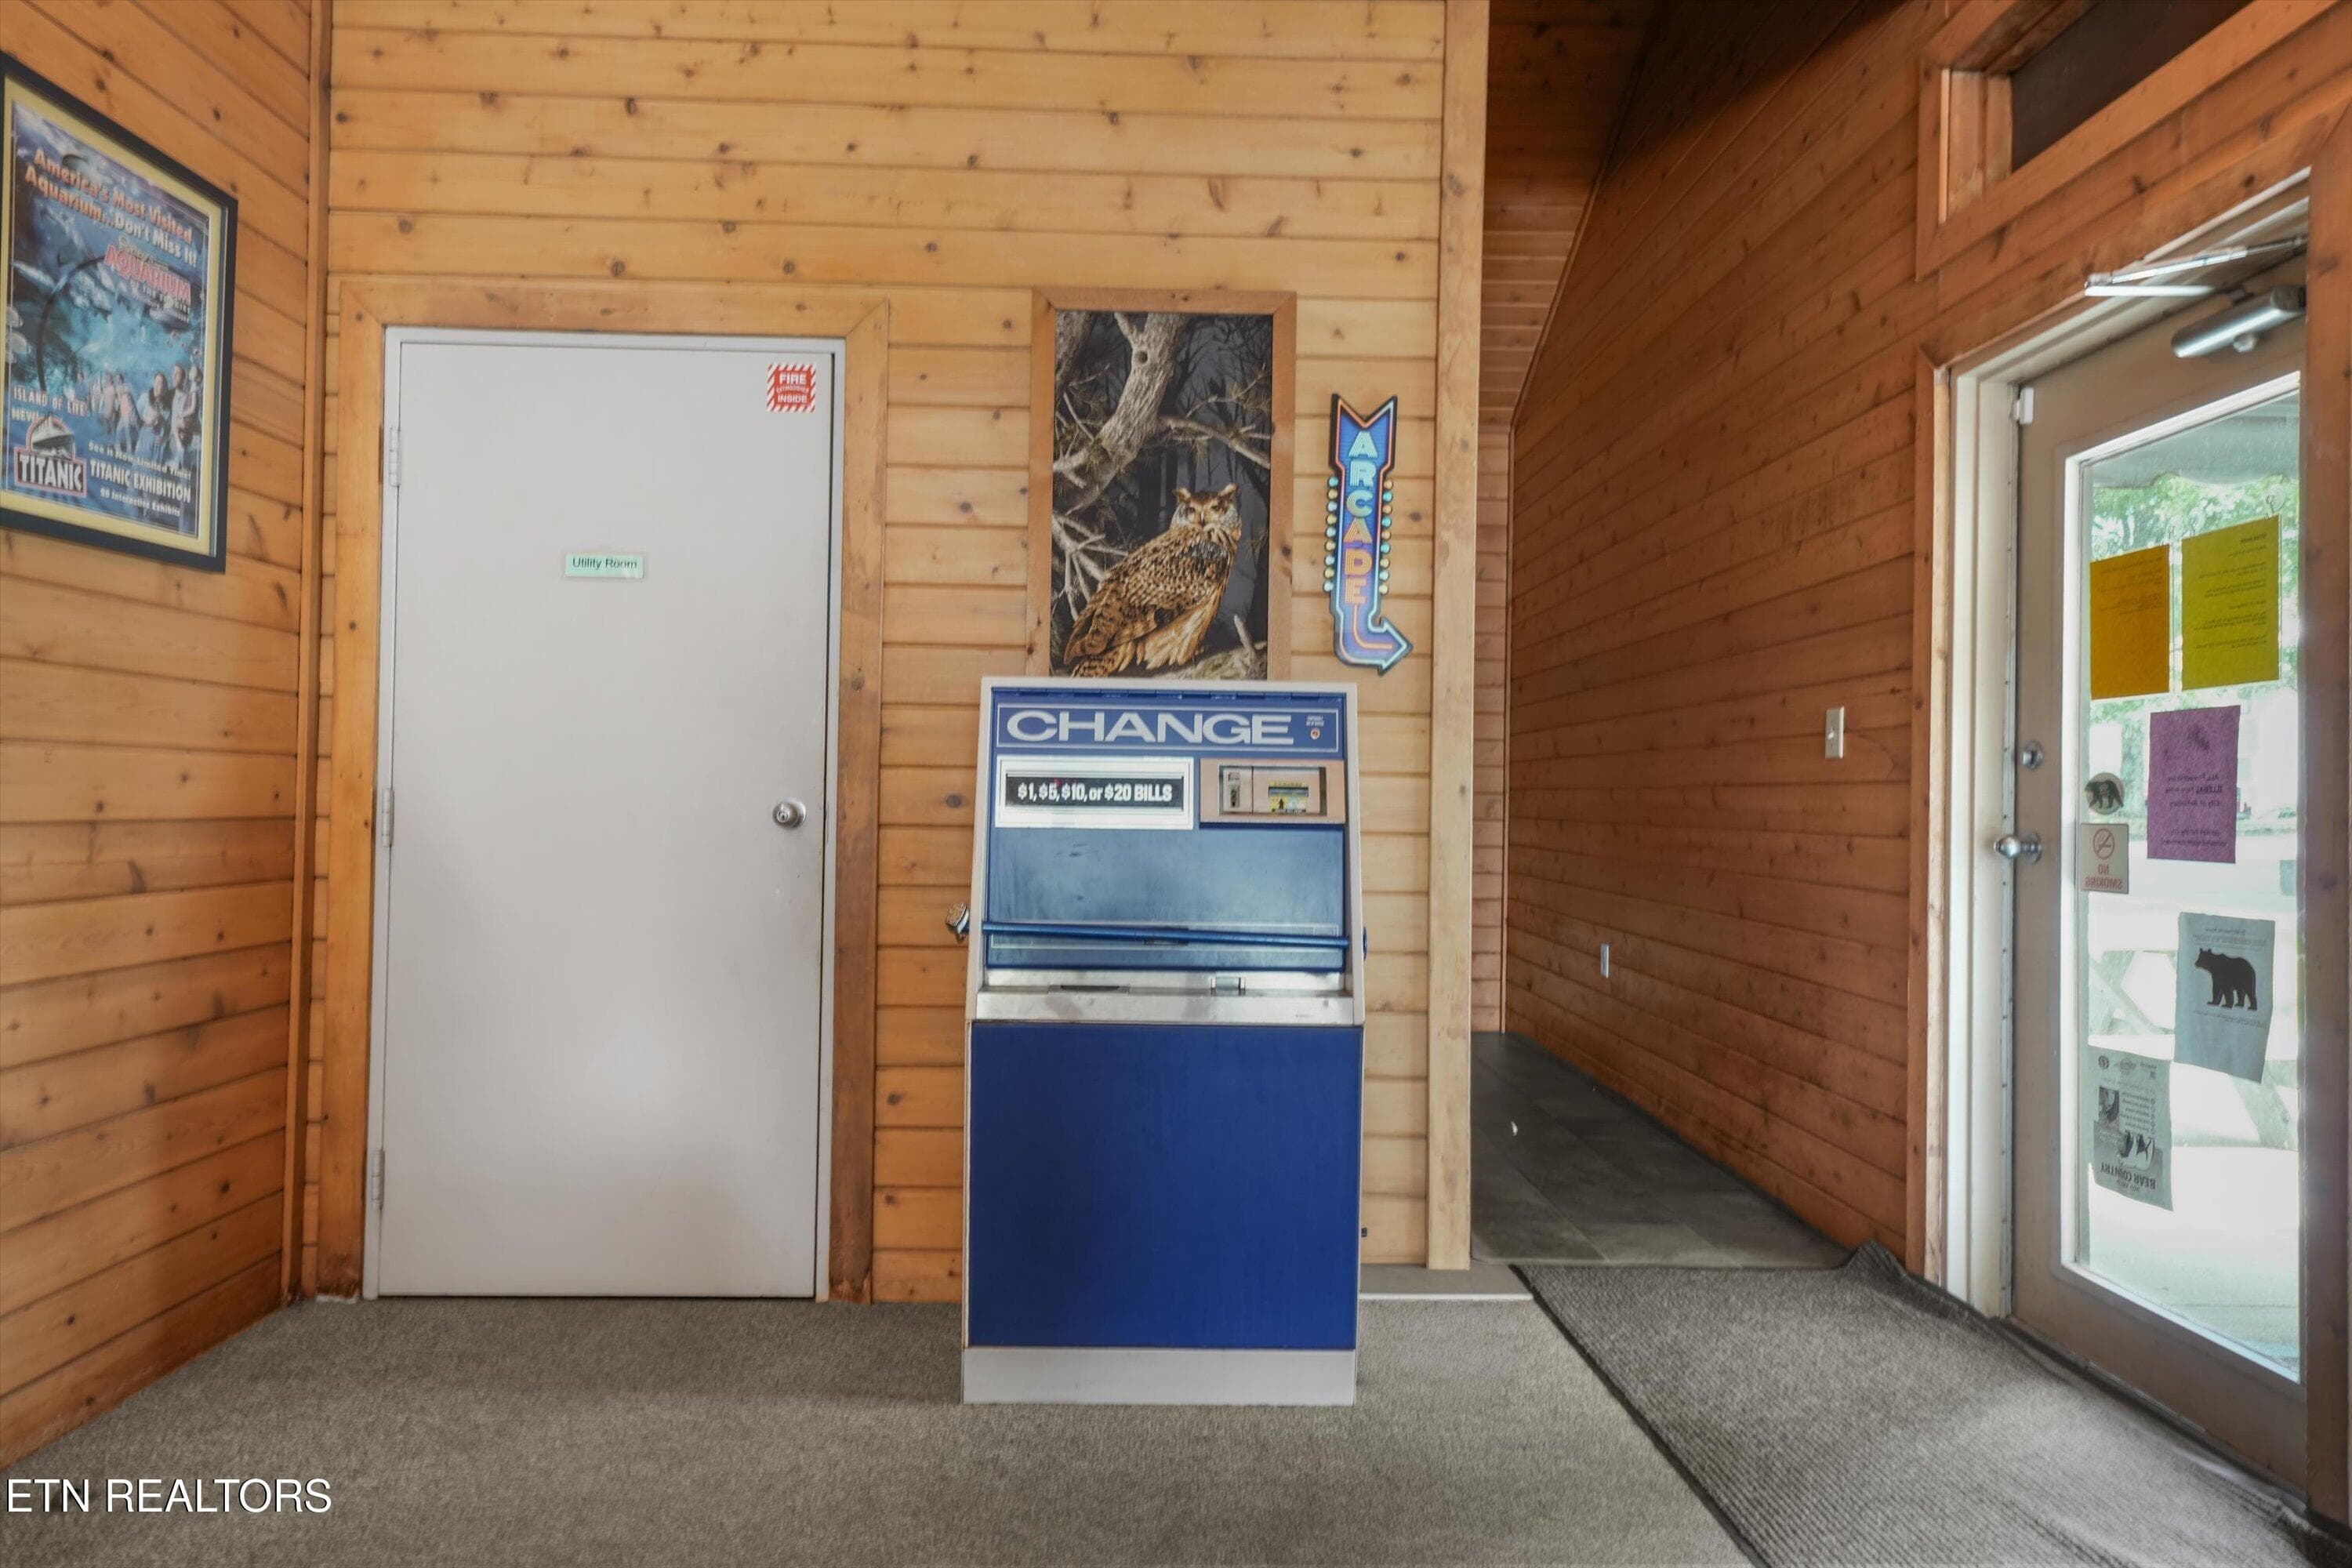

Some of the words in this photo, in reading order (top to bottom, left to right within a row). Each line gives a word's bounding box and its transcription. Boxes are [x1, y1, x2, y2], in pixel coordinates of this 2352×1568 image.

[33, 147, 109, 204] America's
[112, 187, 146, 219] Most
[149, 205, 192, 245] Visited
[152, 229, 182, 259] Miss
[104, 242, 191, 308] AQUARIUM
[779, 372, 807, 385] FIRE
[13, 385, 47, 407] ISLAND
[52, 394, 64, 410] OF
[19, 454, 82, 492] TITANIC
[90, 459, 132, 487] TITANIC
[134, 472, 191, 503] EXHIBITION
[1343, 430, 1378, 604] ARCADE
[572, 557, 602, 570] Utility
[604, 558, 637, 568] Room
[1007, 710, 1294, 745] CHANGE
[1104, 783, 1131, 801] $20
[1134, 783, 1173, 802] BILLS
